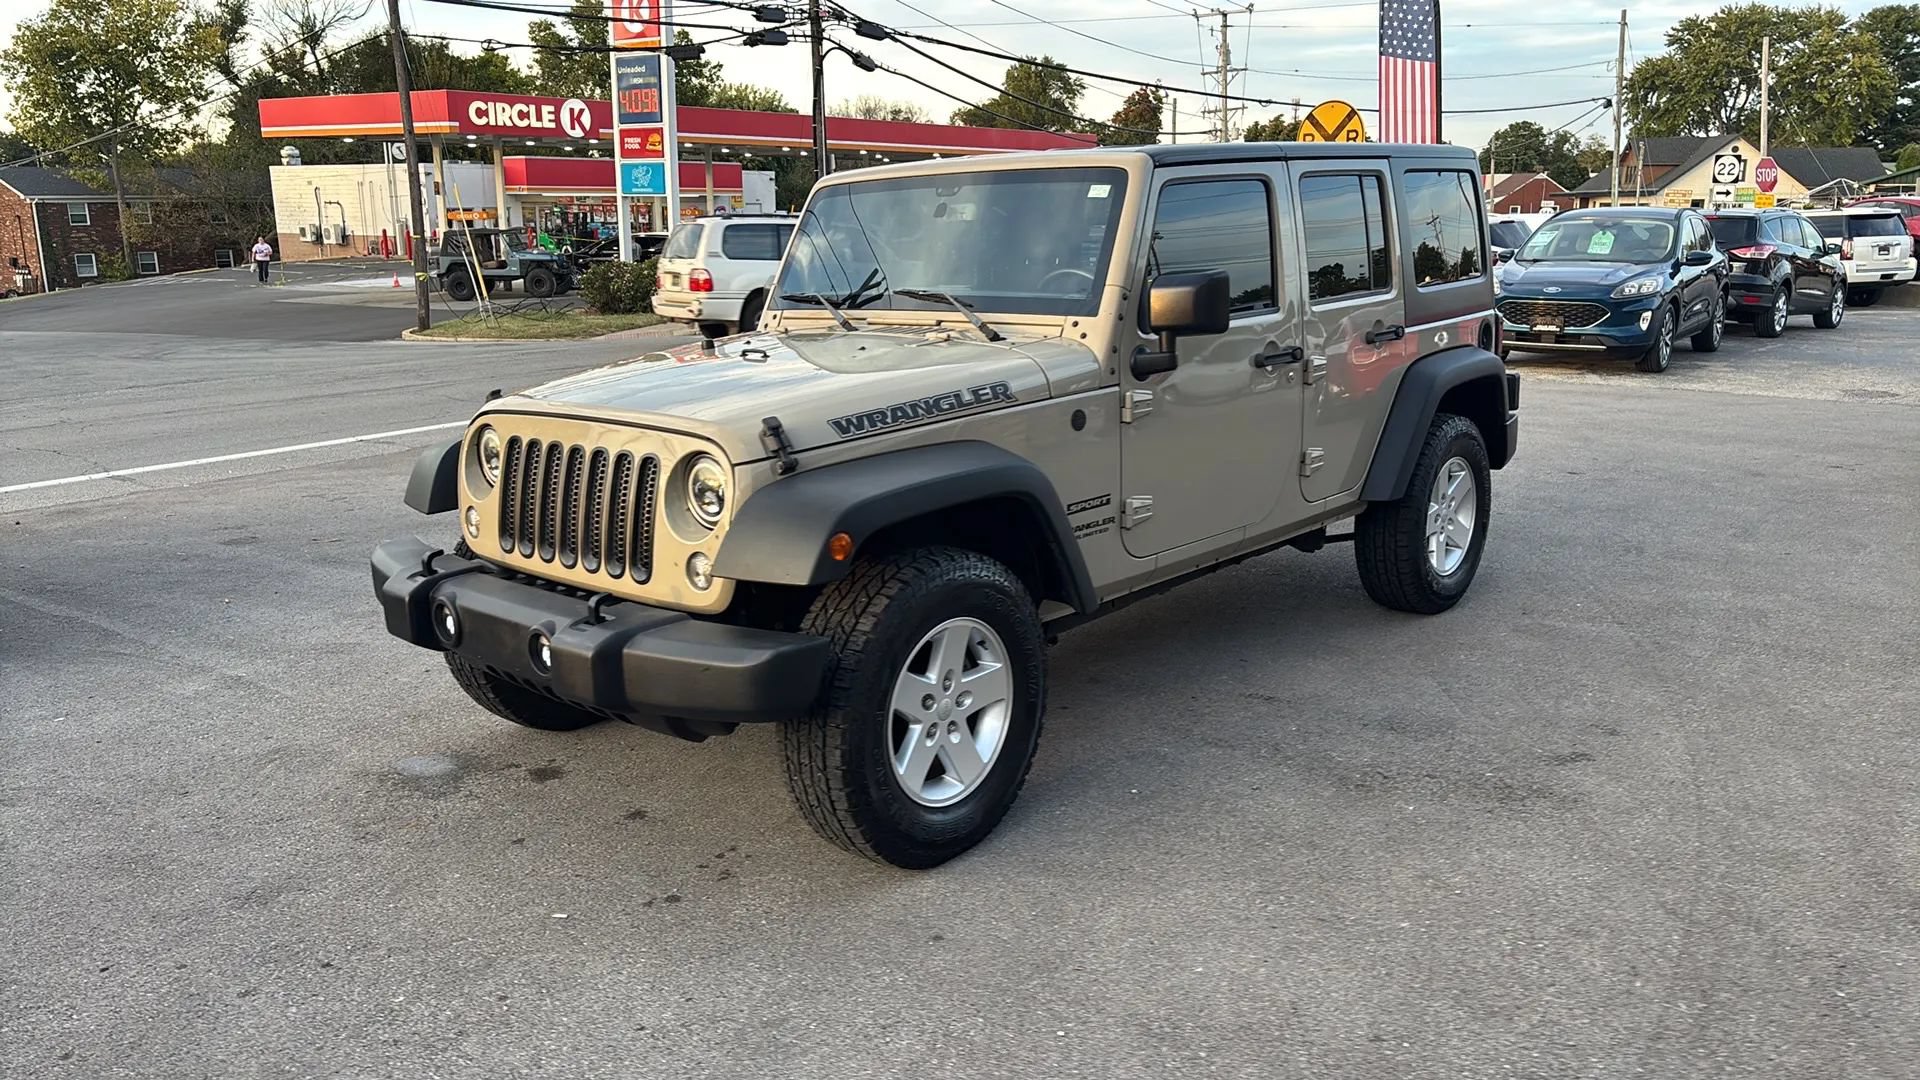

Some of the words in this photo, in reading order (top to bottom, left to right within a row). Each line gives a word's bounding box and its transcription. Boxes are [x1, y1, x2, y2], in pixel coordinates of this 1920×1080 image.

[617, 64, 646, 74] Unleaded
[468, 100, 556, 129] CIRCLE
[1717, 162, 1736, 176] 22
[1756, 168, 1777, 182] STOP
[828, 381, 1019, 438] WRANGLER
[1068, 496, 1109, 512] SPORT
[1072, 515, 1116, 533] ANGLER
[1075, 527, 1110, 539] LIMITED
